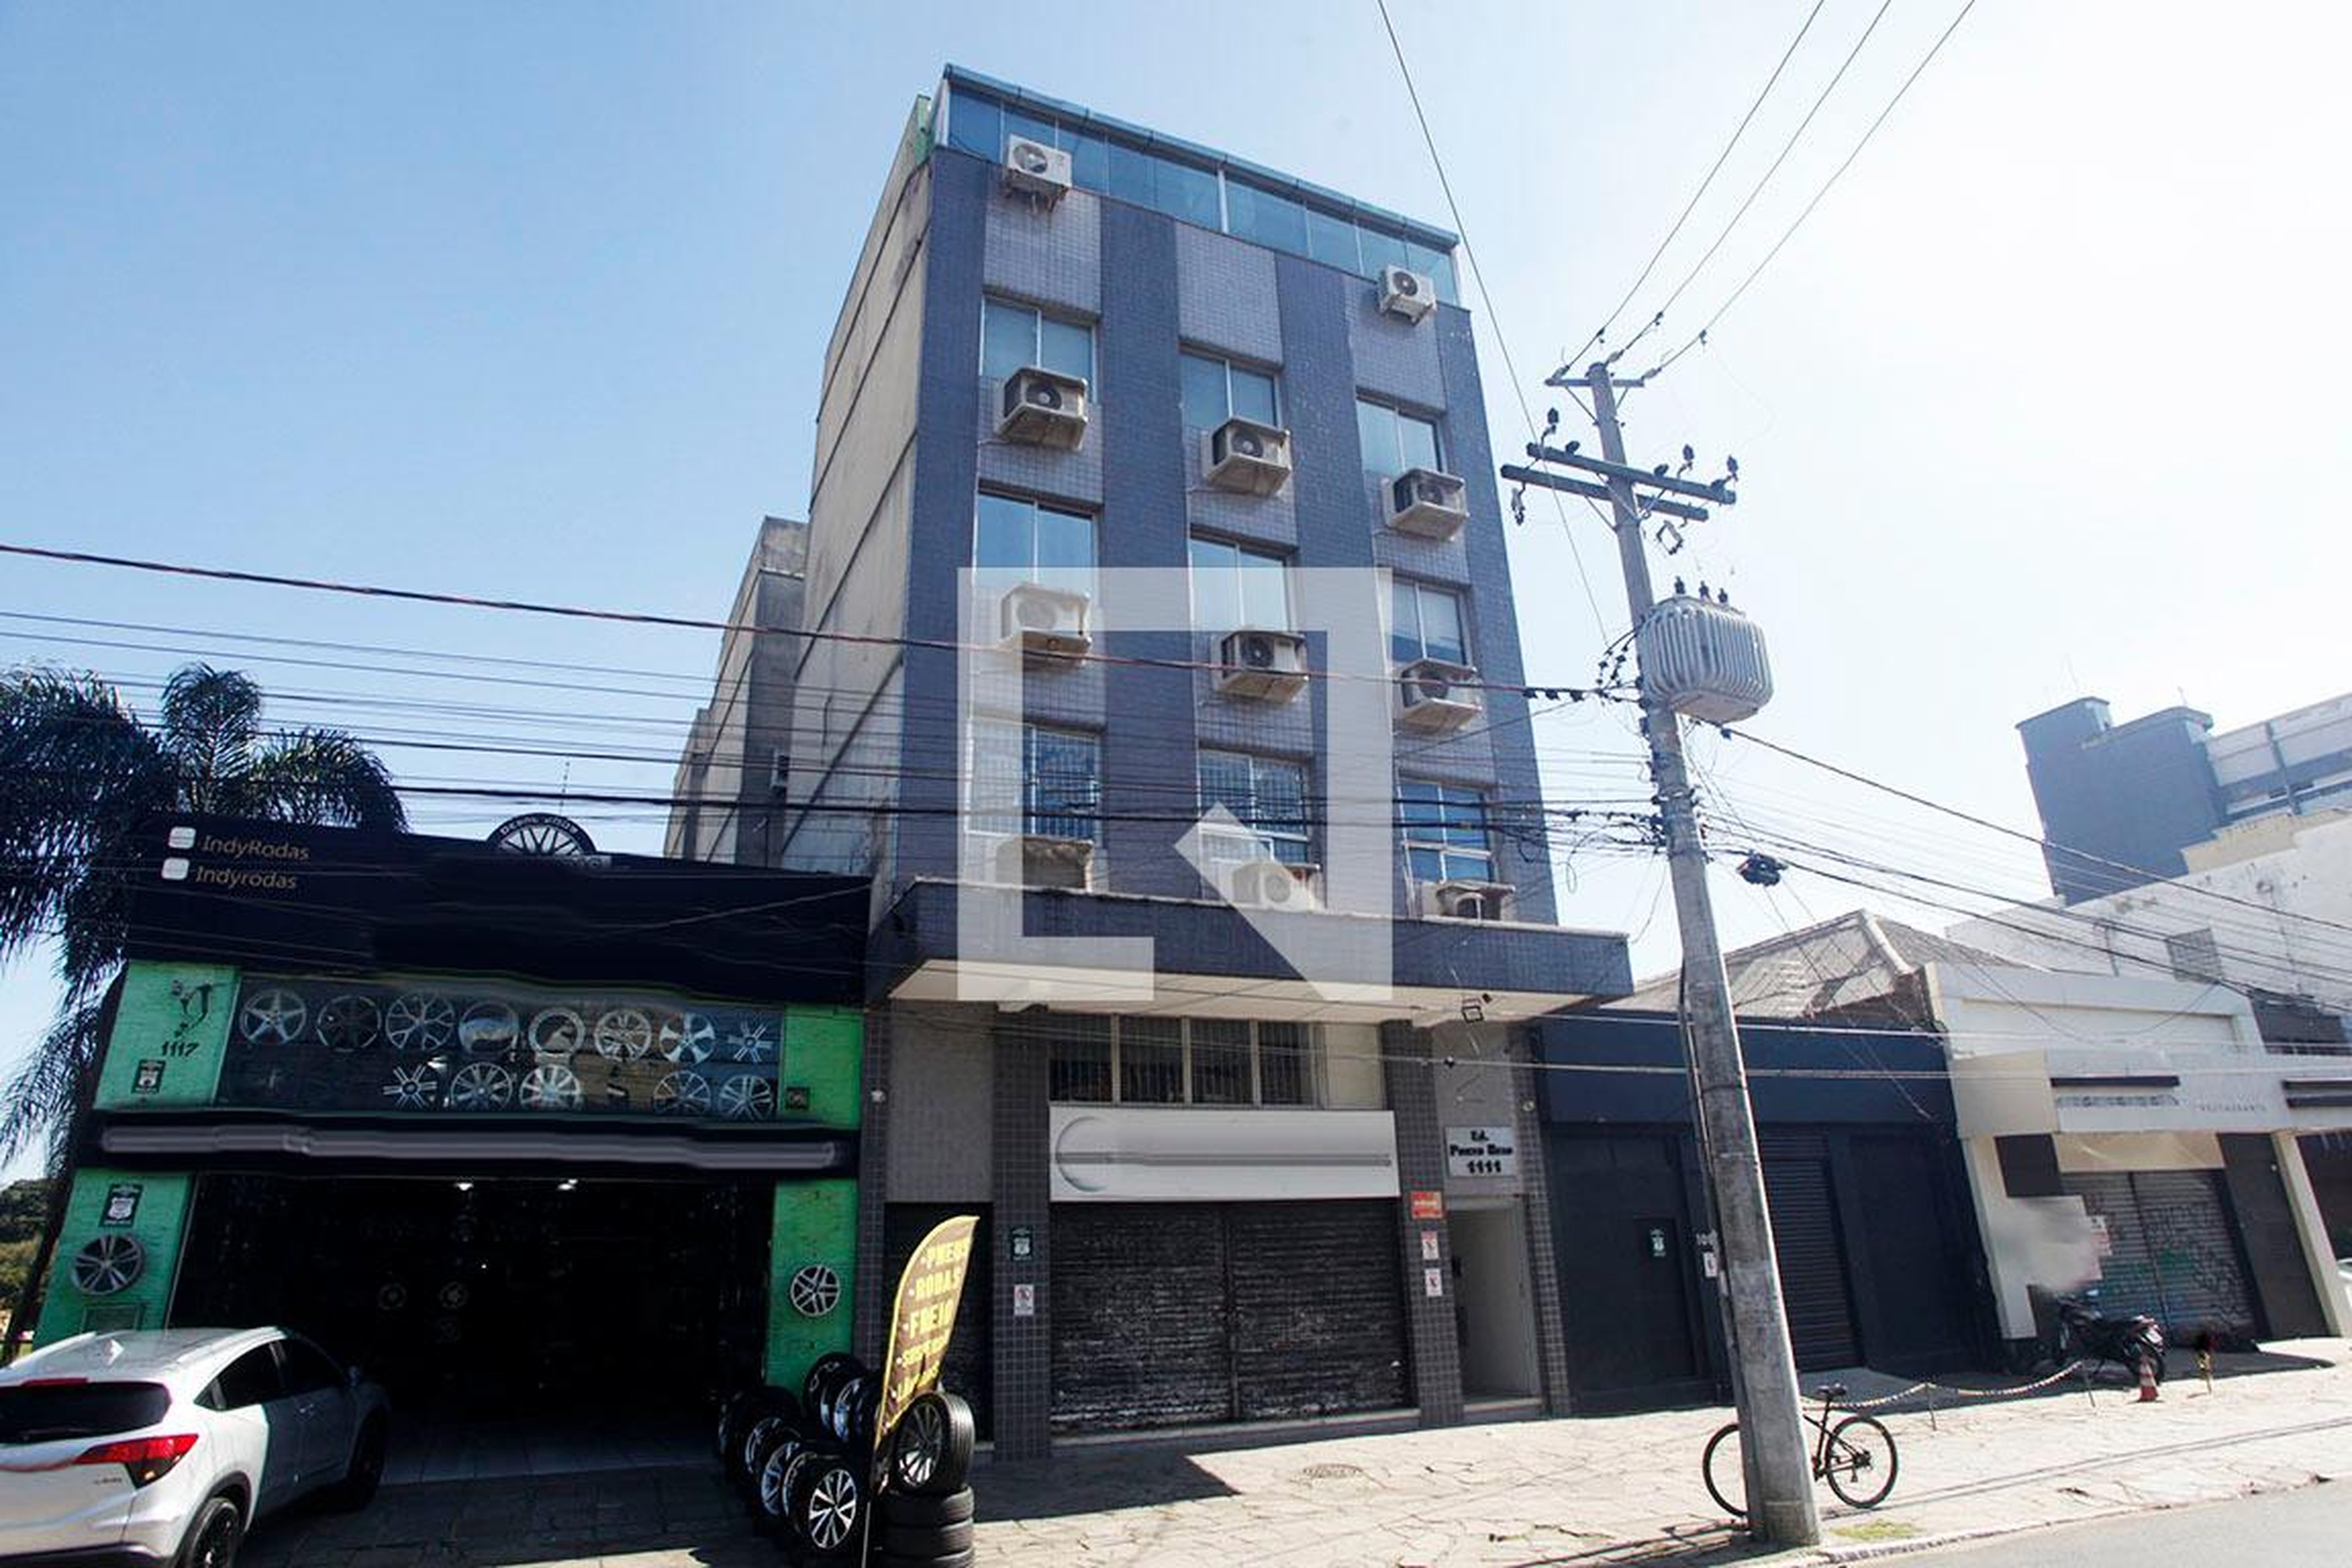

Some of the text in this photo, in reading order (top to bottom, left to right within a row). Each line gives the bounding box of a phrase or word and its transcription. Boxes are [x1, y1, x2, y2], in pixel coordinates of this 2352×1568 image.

[202, 835, 309, 860] IndyRodas
[195, 865, 298, 889] Indyrodas
[161, 1041, 200, 1057] 1117
[1467, 1159, 1502, 1174] 1111
[914, 1267, 962, 1301] RODAS
